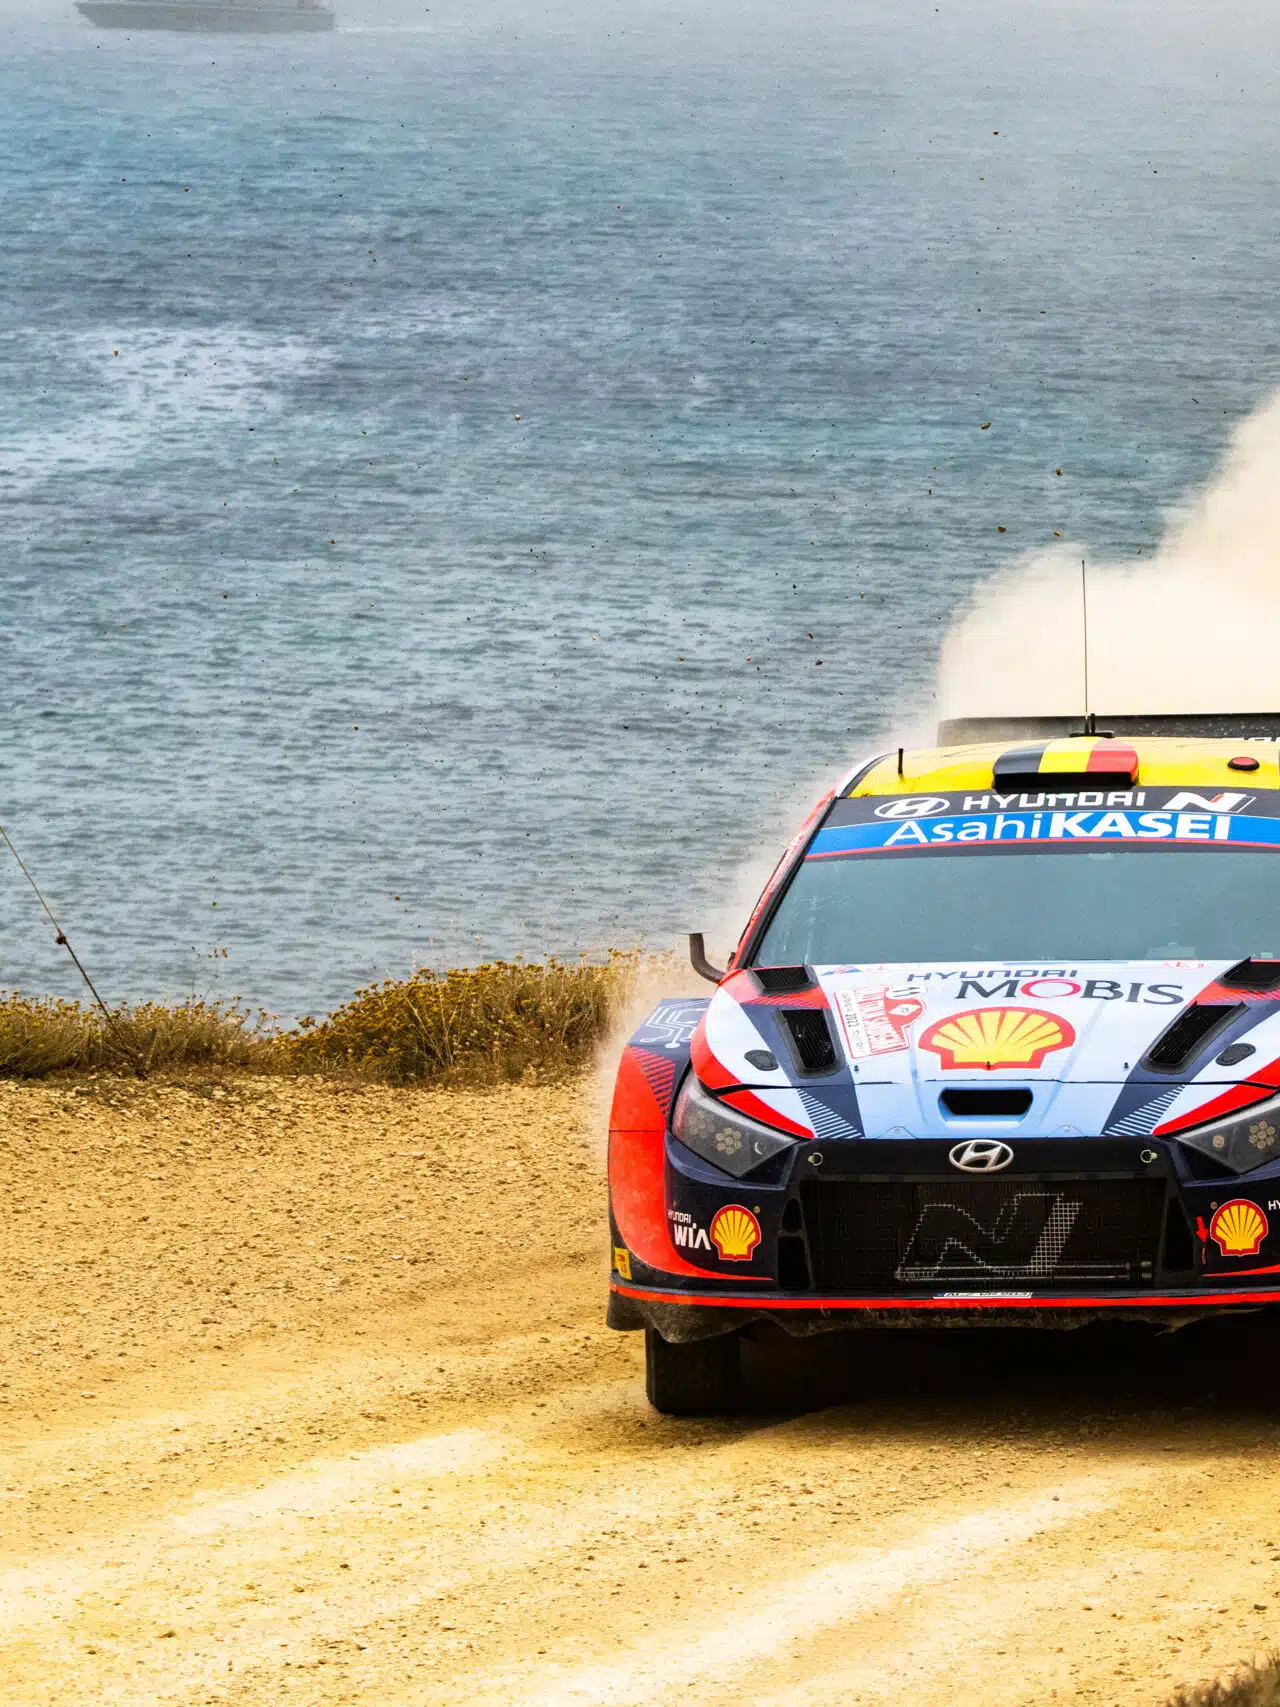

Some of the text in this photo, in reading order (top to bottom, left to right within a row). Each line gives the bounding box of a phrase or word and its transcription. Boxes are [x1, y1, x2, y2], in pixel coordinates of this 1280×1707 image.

[963, 791, 1146, 812] HYUNDAI
[906, 969, 1078, 982] HYUNDAI
[955, 978, 1184, 1005] MOBIS
